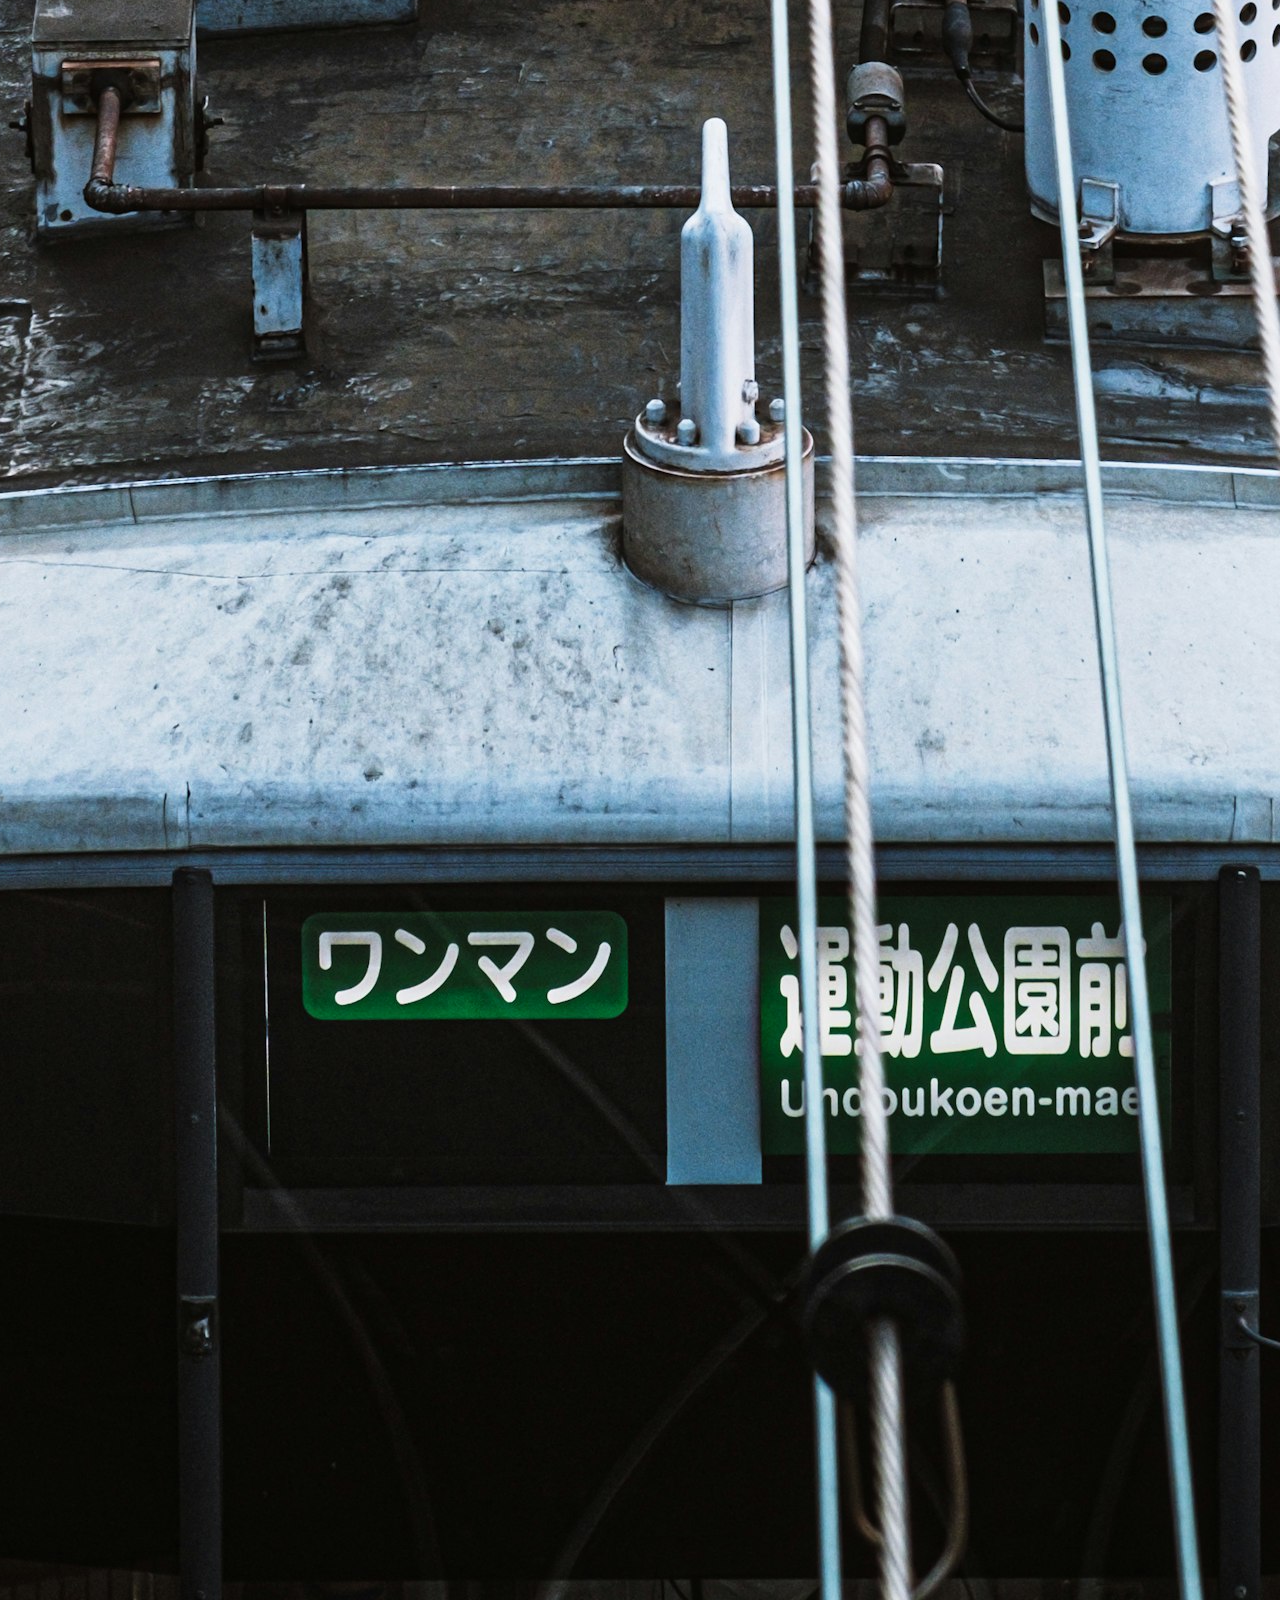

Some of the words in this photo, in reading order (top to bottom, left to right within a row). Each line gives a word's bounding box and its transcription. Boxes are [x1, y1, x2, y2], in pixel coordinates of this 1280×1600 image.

[319, 927, 612, 1006] ワンマン
[779, 921, 1148, 1059] 運動公園前
